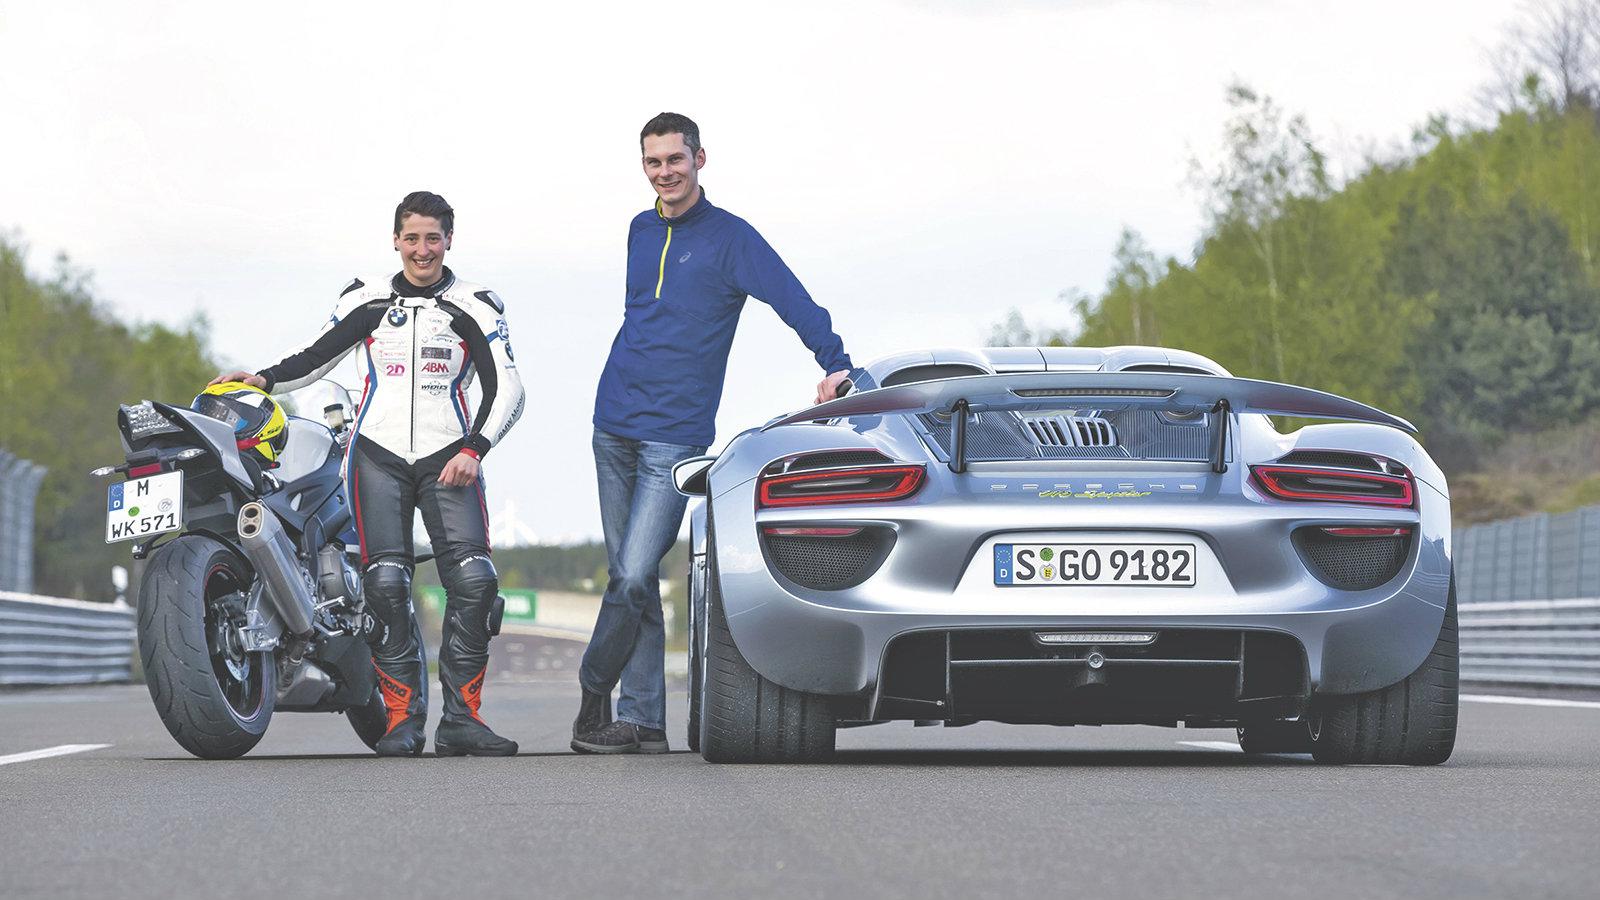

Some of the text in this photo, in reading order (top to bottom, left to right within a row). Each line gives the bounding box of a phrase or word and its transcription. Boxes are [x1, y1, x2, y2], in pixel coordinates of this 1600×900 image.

[386, 364, 405, 376] 2D
[421, 362, 449, 373] ABM
[137, 479, 149, 497] M
[113, 500, 121, 509] D
[112, 512, 176, 538] WK 571
[1016, 549, 1191, 581] S GO 9182
[1000, 568, 1008, 578] D
